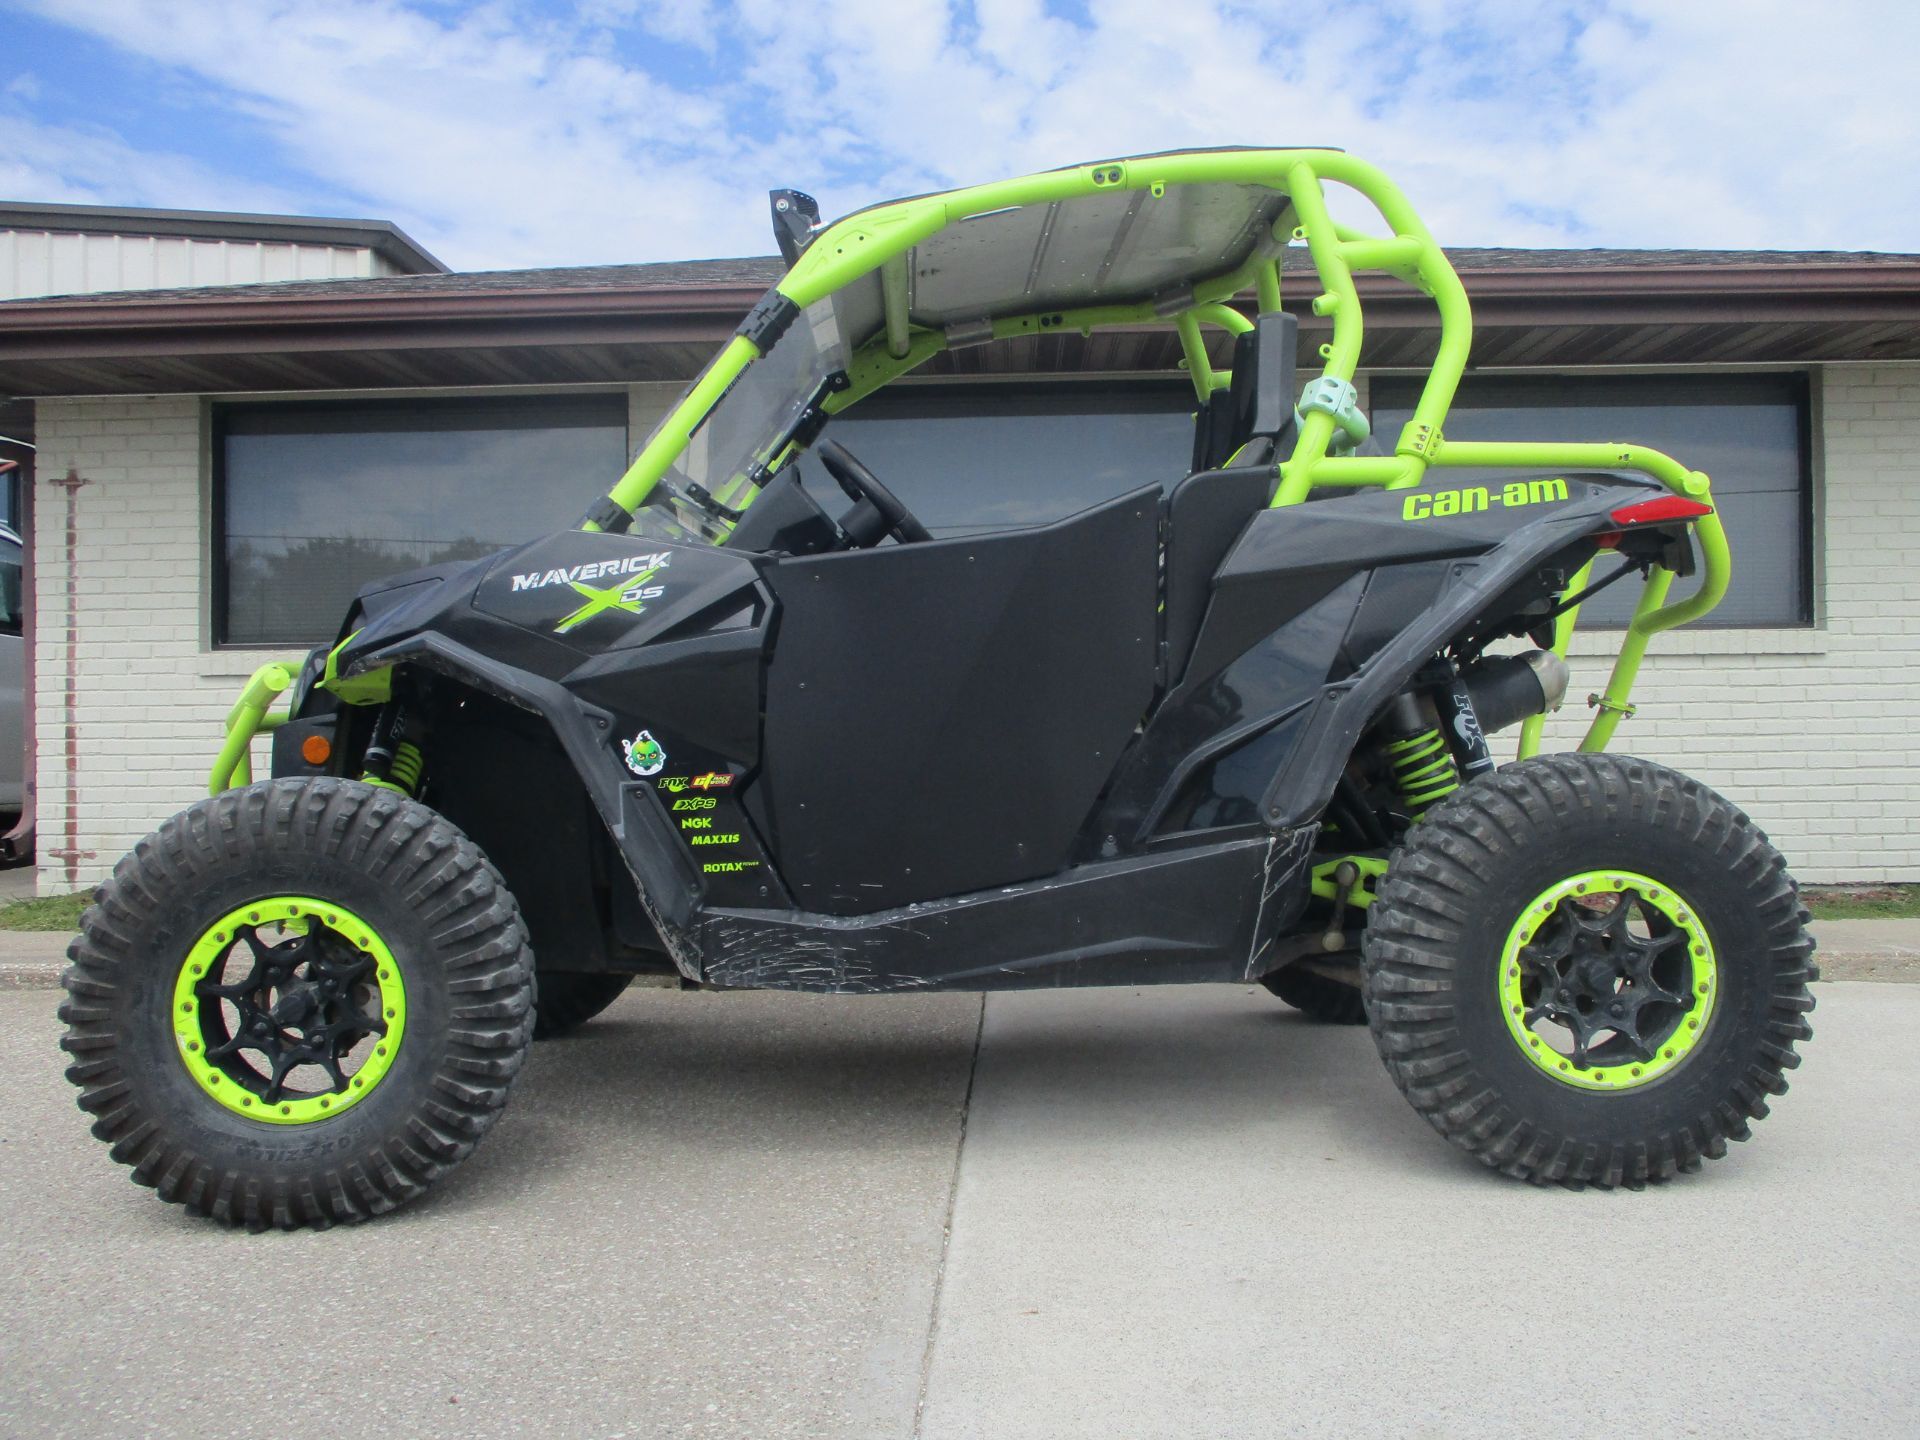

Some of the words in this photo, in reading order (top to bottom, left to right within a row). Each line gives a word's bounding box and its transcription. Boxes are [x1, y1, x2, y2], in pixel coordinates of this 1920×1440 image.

[1403, 478, 1568, 521] can-am
[512, 551, 672, 592] MAVERICK
[1454, 694, 1485, 750] FOX
[657, 777, 689, 792] FOX
[681, 797, 717, 811] XPS
[682, 818, 712, 829] NGK
[692, 834, 740, 845] MAXXIS
[703, 862, 743, 873] ROTAX
